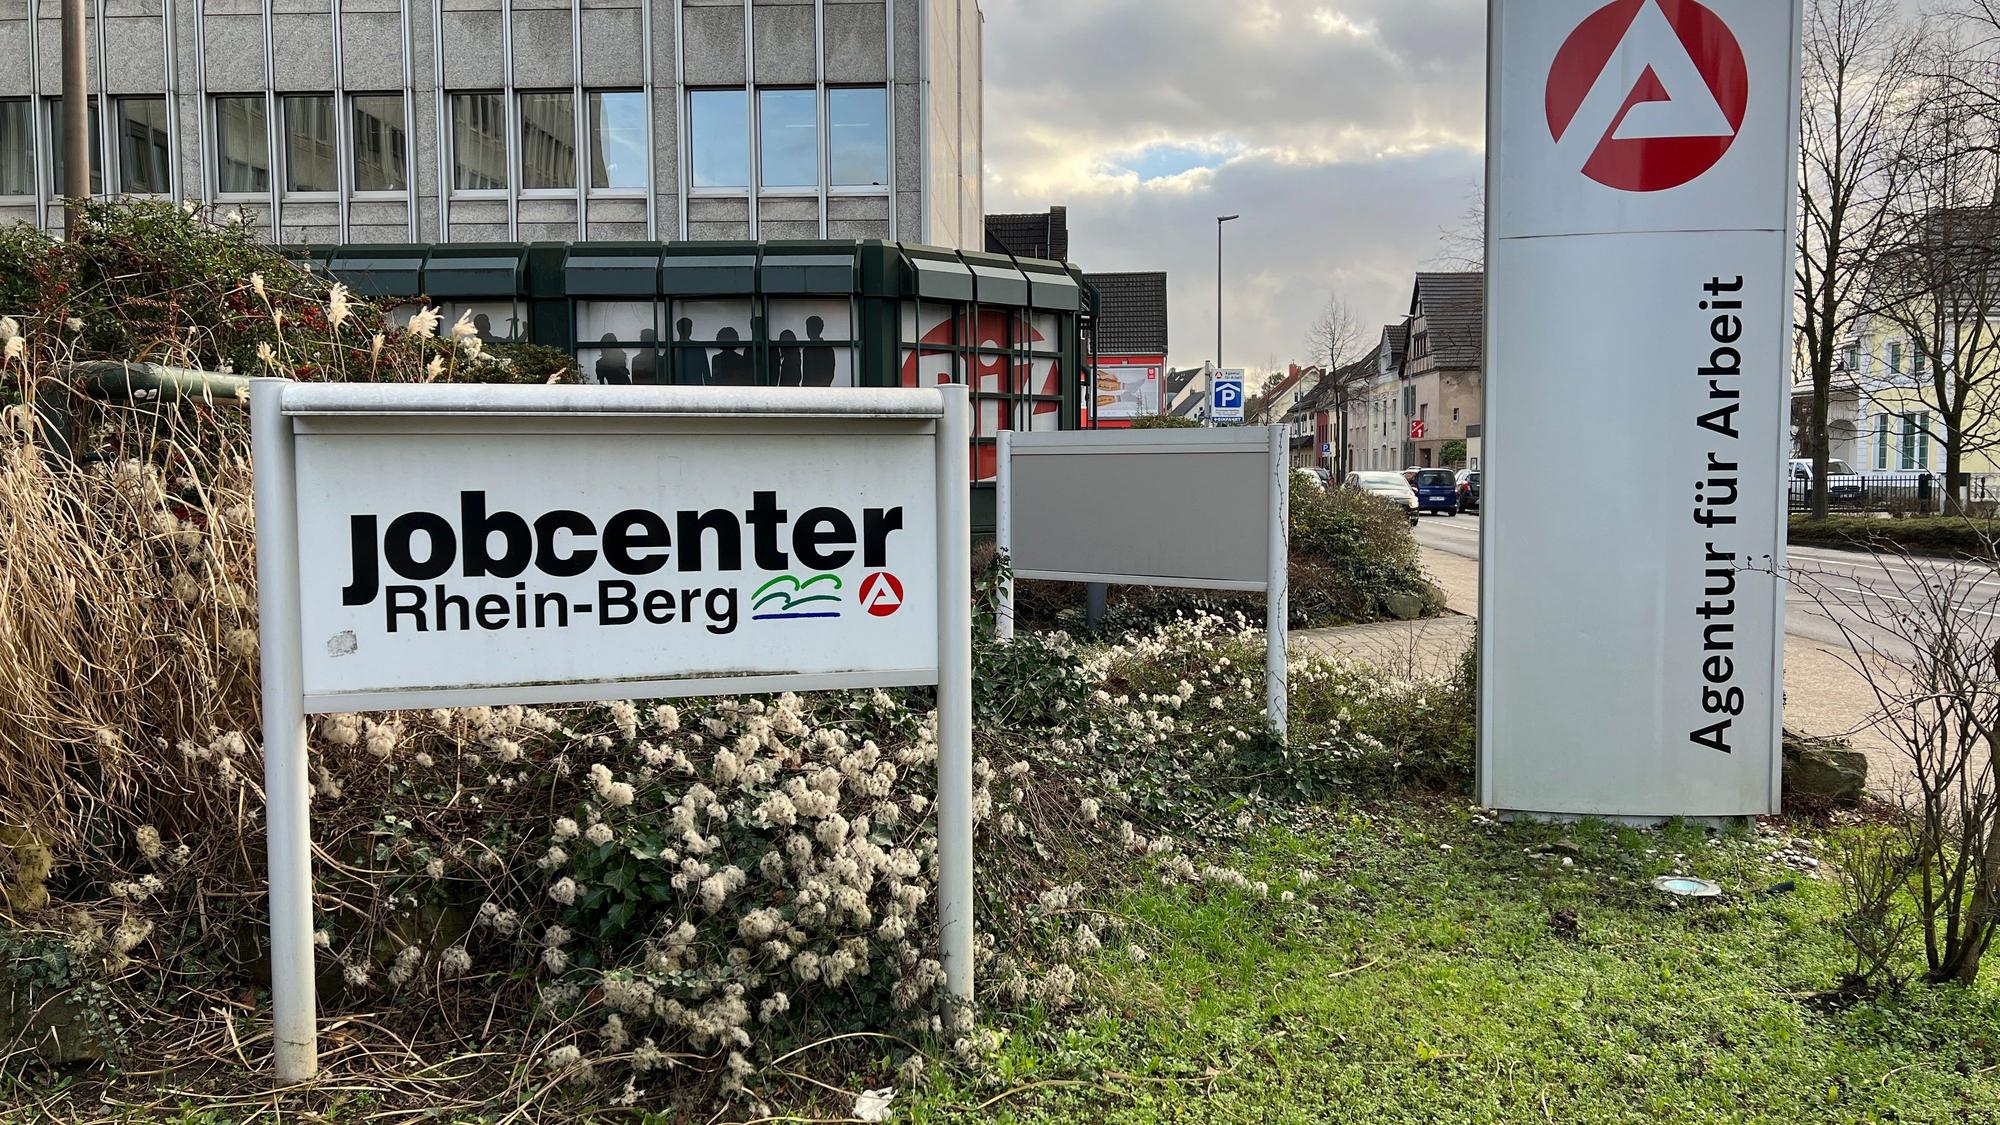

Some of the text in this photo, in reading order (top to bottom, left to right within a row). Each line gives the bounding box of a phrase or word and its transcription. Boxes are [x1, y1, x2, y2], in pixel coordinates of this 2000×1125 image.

[1221, 389, 1236, 407] P
[342, 490, 903, 606] jobcenter
[1690, 275, 1745, 754] Agentur für Arbeit
[385, 579, 738, 635] Rhein-Berg
